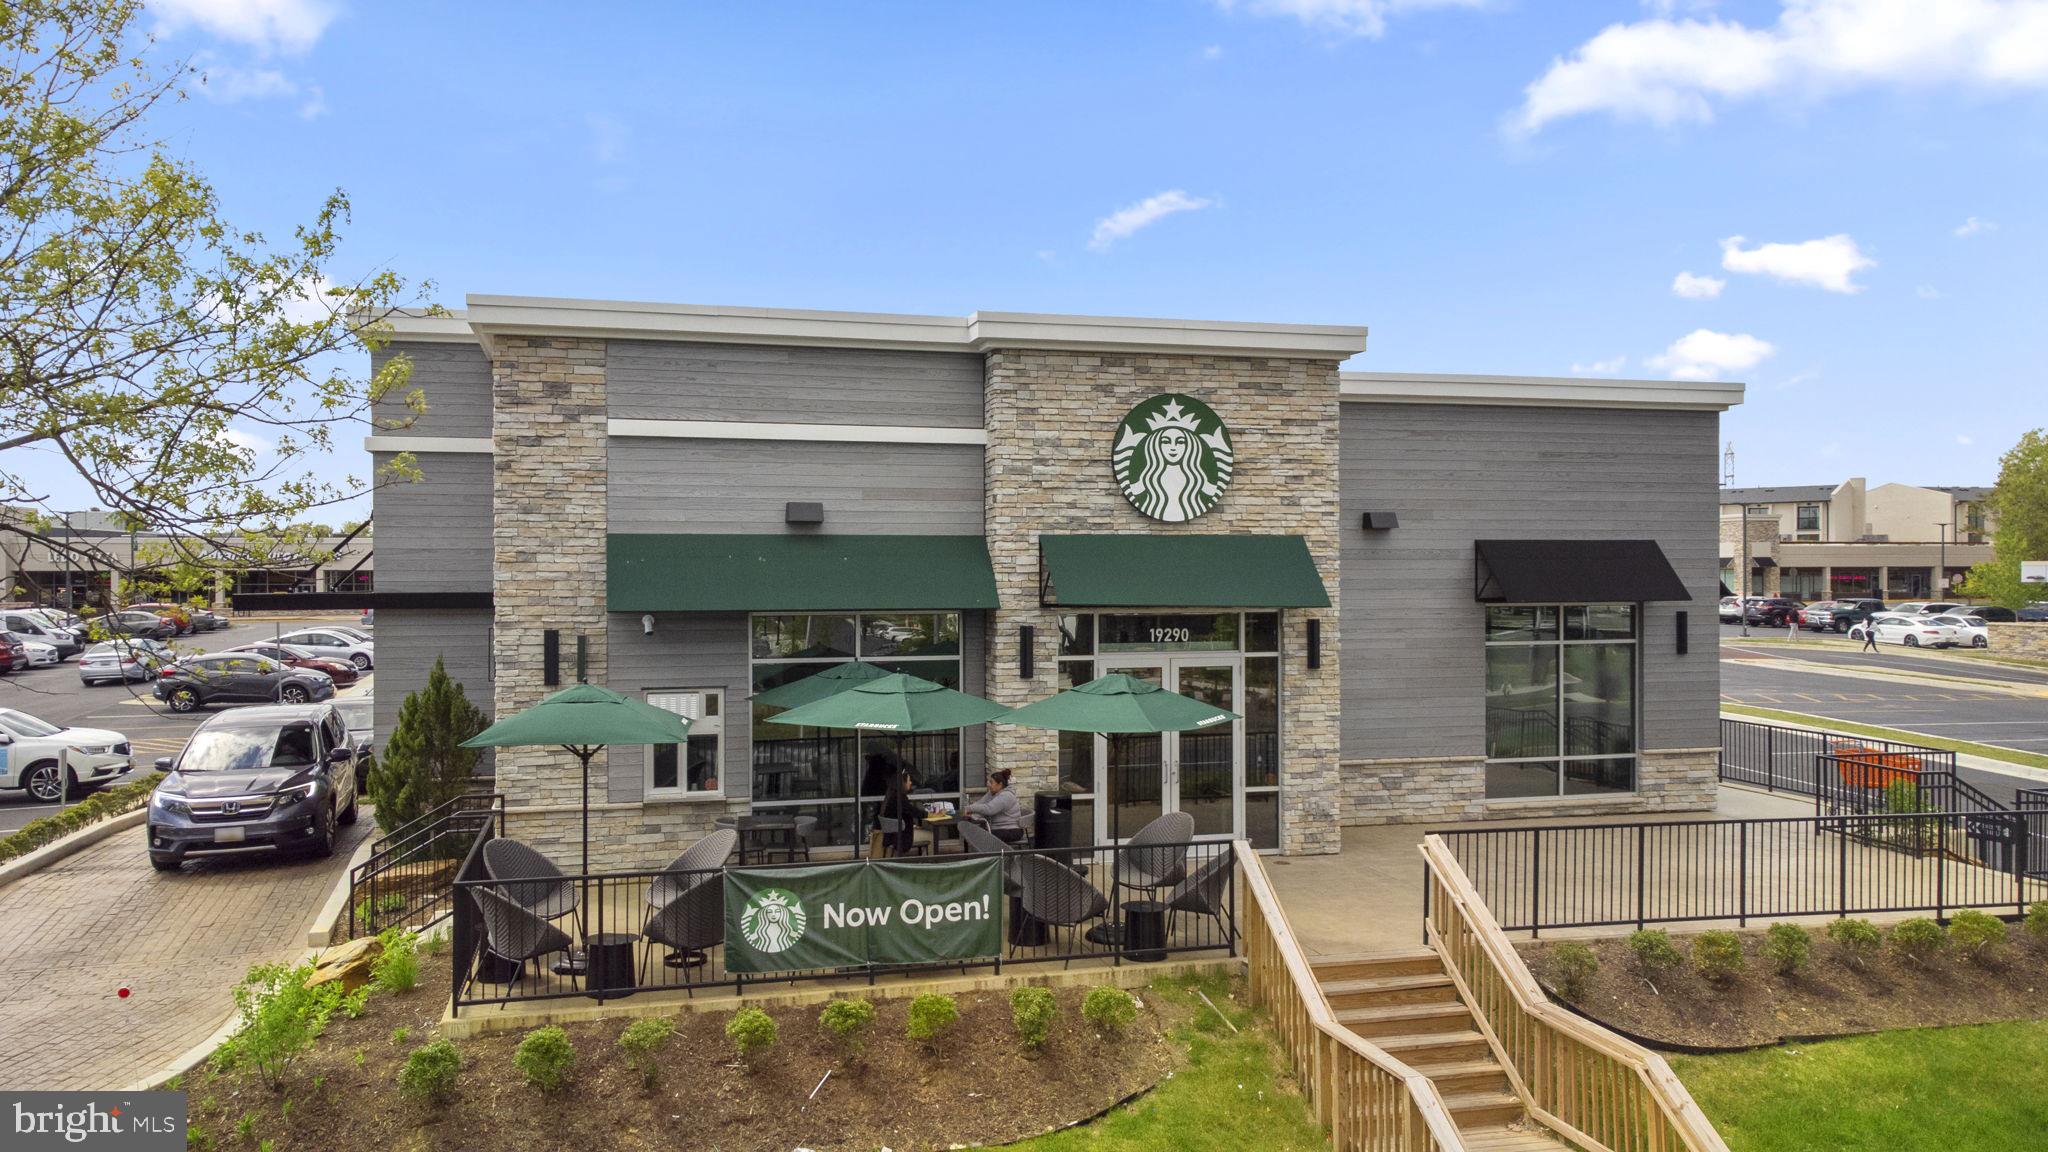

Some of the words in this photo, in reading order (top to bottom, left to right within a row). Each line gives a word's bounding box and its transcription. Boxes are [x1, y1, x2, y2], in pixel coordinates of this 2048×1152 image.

[1149, 627, 1189, 642] 19290
[823, 902, 892, 929] Now
[900, 894, 990, 930] Open!
